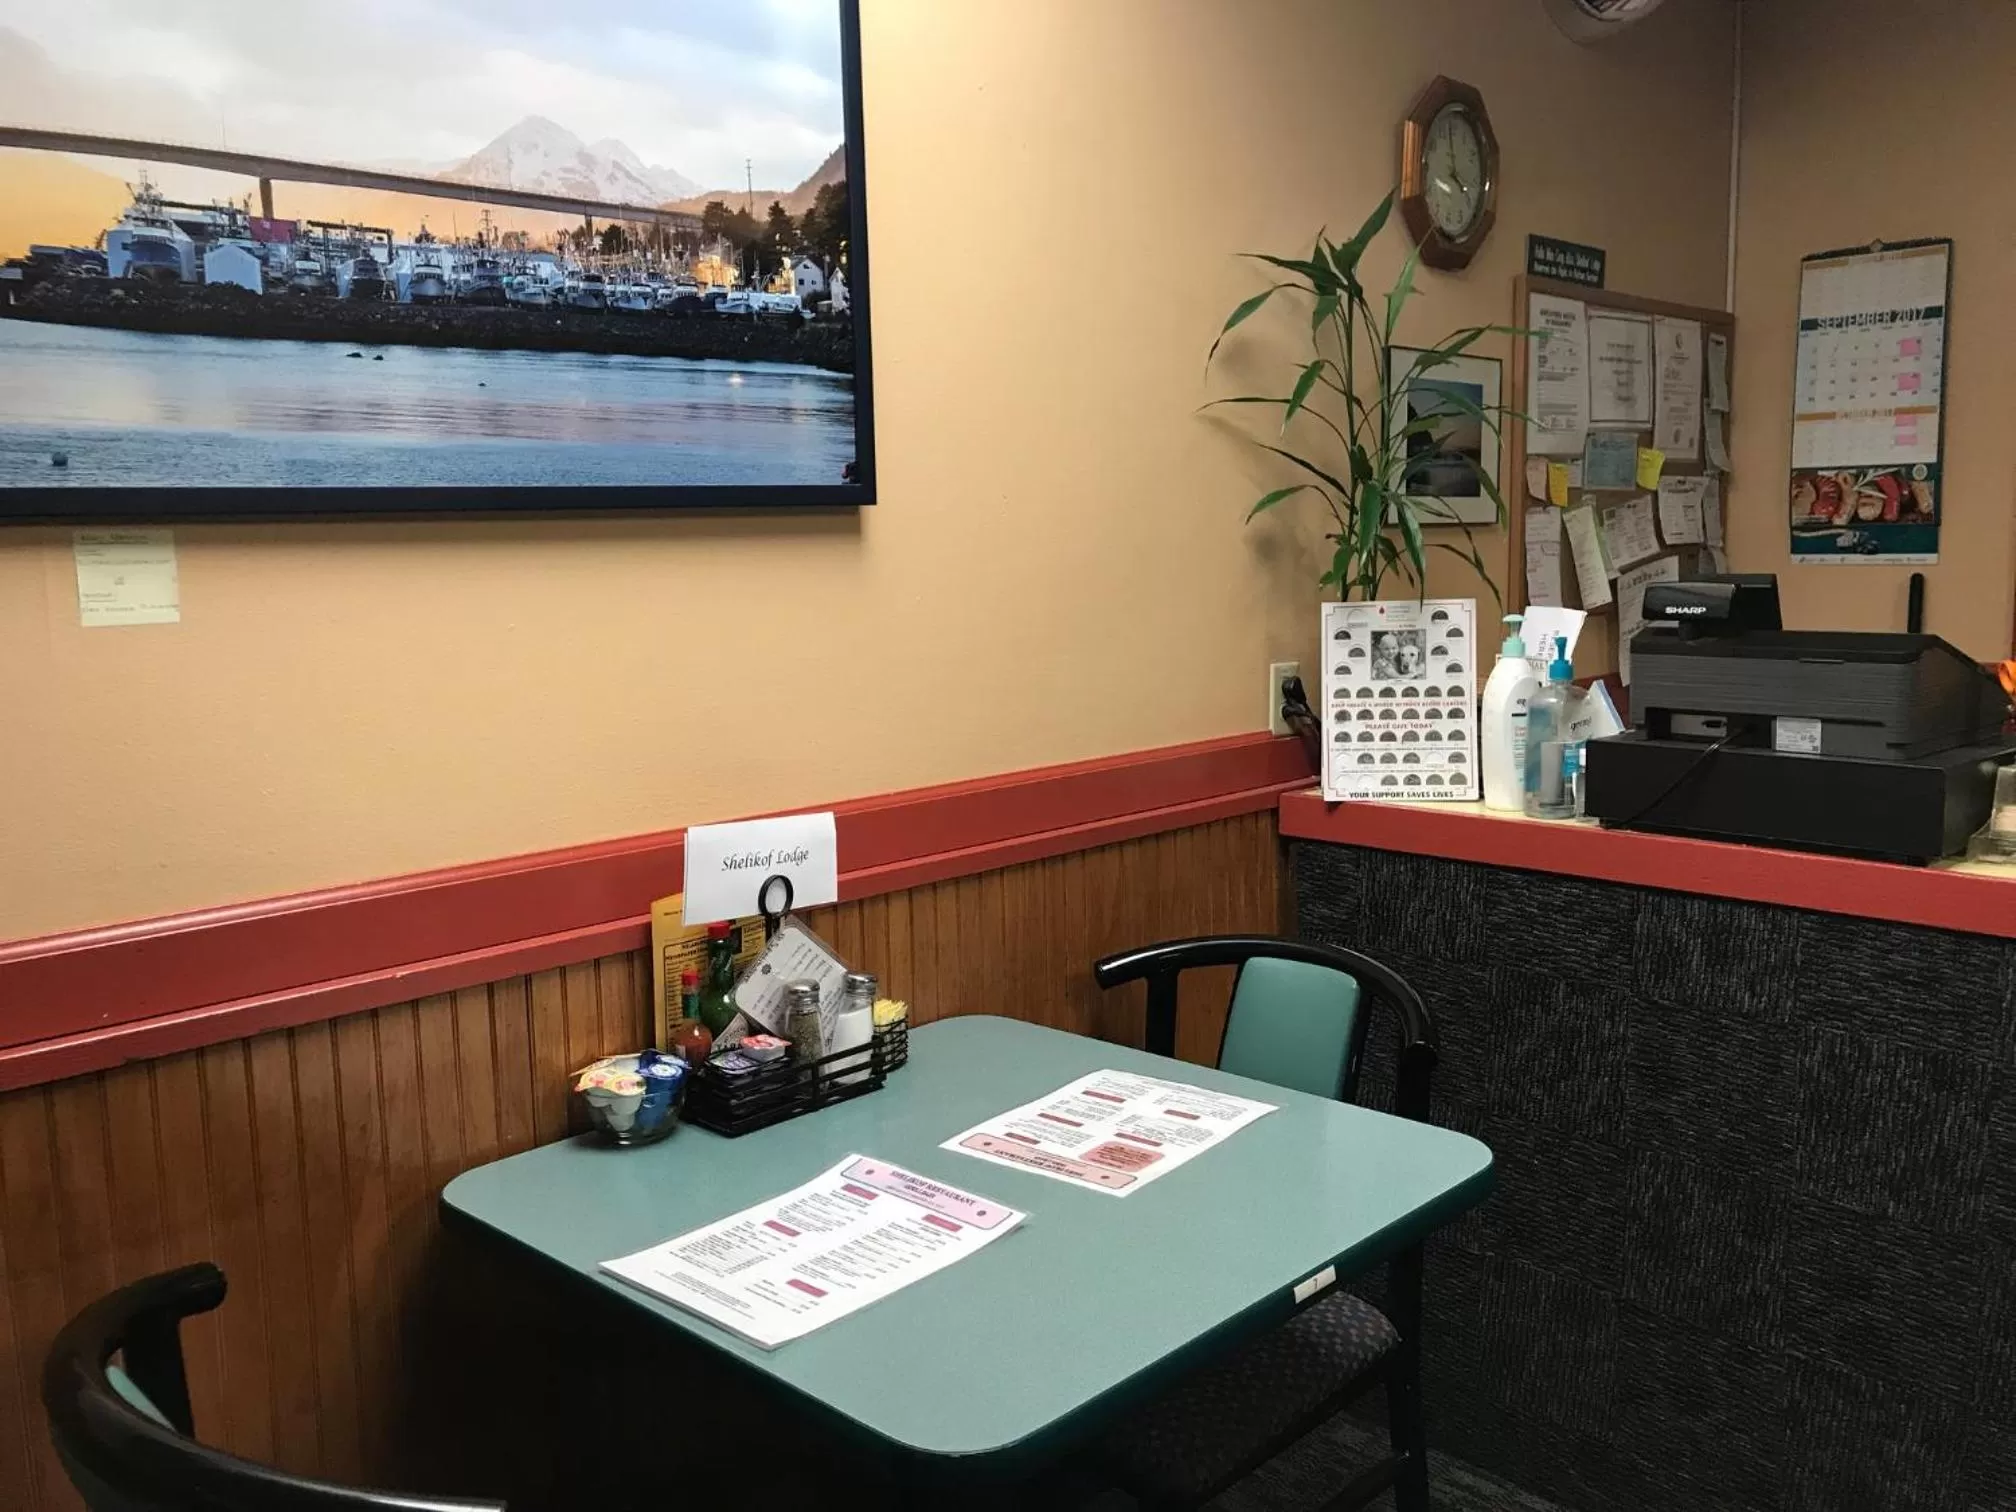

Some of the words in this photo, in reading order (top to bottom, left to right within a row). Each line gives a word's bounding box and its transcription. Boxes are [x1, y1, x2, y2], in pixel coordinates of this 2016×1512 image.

[1817, 311, 1891, 329] SEPTEMBER
[1896, 308, 1925, 322] 2017
[1665, 606, 1706, 614] SHARP
[1348, 791, 1370, 799] YOUR
[1371, 791, 1405, 799] SUPPORT
[1406, 790, 1431, 798] SAVES
[1432, 790, 1454, 798] LIVES
[721, 850, 774, 872] Shelikof
[776, 845, 810, 867] Lodge
